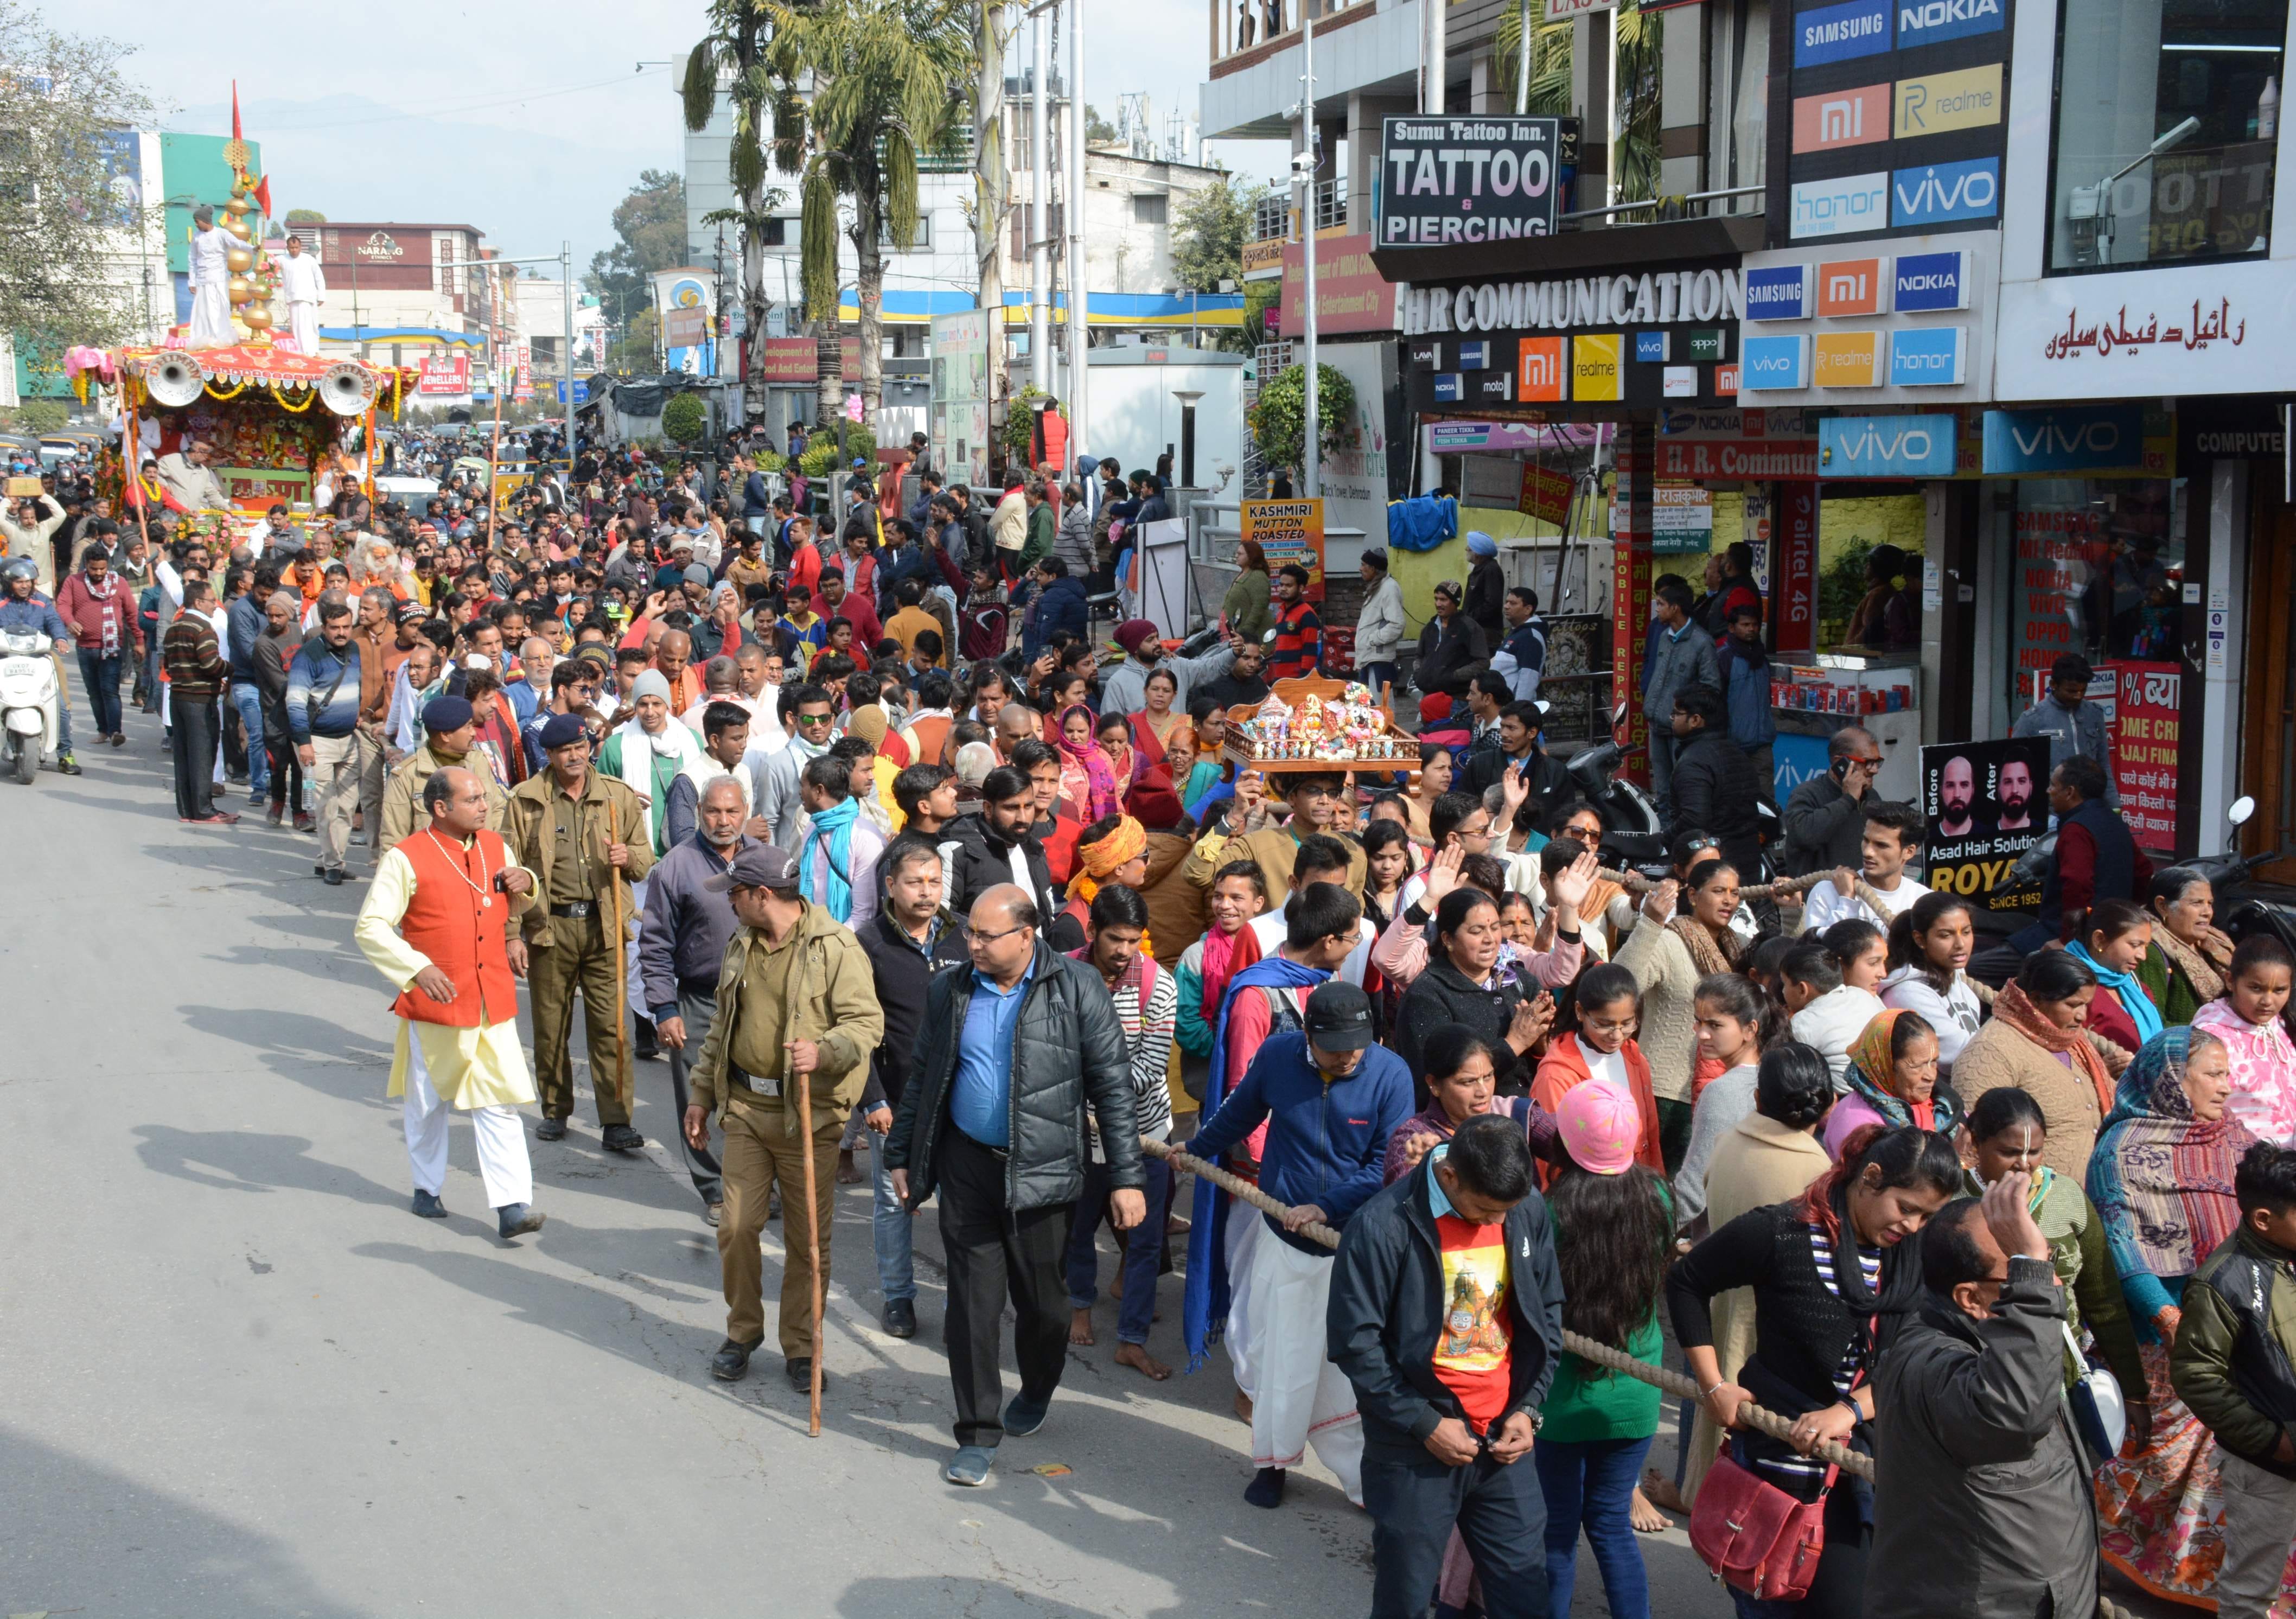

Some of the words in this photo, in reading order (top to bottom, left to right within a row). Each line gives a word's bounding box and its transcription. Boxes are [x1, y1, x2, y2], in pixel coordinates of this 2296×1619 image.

[1901, 0, 1999, 31] NOKIA
[1806, 14, 1883, 47] SAMSUNG
[1936, 90, 1992, 114] realme
[1394, 123, 1445, 141] Sumu
[1450, 122, 1507, 141] Tattoo
[1511, 122, 1546, 142] Inn.
[1389, 149, 1550, 197] TATTOO
[1897, 168, 1995, 215] vivo
[1462, 199, 1472, 210] &
[1797, 190, 1883, 221] honor
[1387, 216, 1547, 242] PIERCING
[1898, 273, 1956, 292] NOKIA
[1366, 289, 1380, 317] City
[1748, 283, 1801, 304] SAMSUNG
[767, 311, 783, 320] oint
[1638, 341, 1662, 353] vivo
[1691, 339, 1717, 350] oppo
[1414, 352, 1433, 360] LAVA
[1460, 351, 1482, 360] SAMSUNG
[1753, 355, 1790, 370] vivo
[1831, 349, 1871, 366] realme
[1896, 348, 1951, 369] honor
[778, 364, 792, 373] And
[1577, 359, 1615, 377] realme
[423, 375, 462, 385] JEWELLERS
[1484, 381, 1504, 392] moto
[1699, 416, 1741, 430] NOKIA
[1768, 415, 1803, 432] vivo
[1840, 422, 1931, 461] vivo
[2012, 416, 2119, 455] vivo
[2196, 432, 2285, 458] COMPUTE
[1667, 445, 1688, 473] H.
[1694, 445, 1715, 473] R.
[1721, 444, 1819, 475] Commun
[1249, 505, 1312, 518] KASHMIRI
[2015, 512, 2099, 532] SAMSUNG
[1254, 518, 1303, 529] MUTTON
[1252, 529, 1305, 541] ROASTED
[1793, 519, 1812, 579] airtel
[2025, 568, 2072, 590] NOKIA
[1617, 551, 1628, 630] MOBILE
[1791, 589, 1808, 622] 4G
[2029, 594, 2066, 616] VIVO
[2026, 621, 2070, 643] OPPO
[2150, 748, 2179, 765] FINA
[1929, 769, 1938, 816] Before
[1987, 763, 1997, 801] After
[1930, 843, 1962, 861] Asad
[1965, 840, 1991, 857] Hair
[1930, 859, 2019, 895] ROYA
[1989, 897, 2018, 910] SINCE
[2020, 893, 2042, 906] 1952
